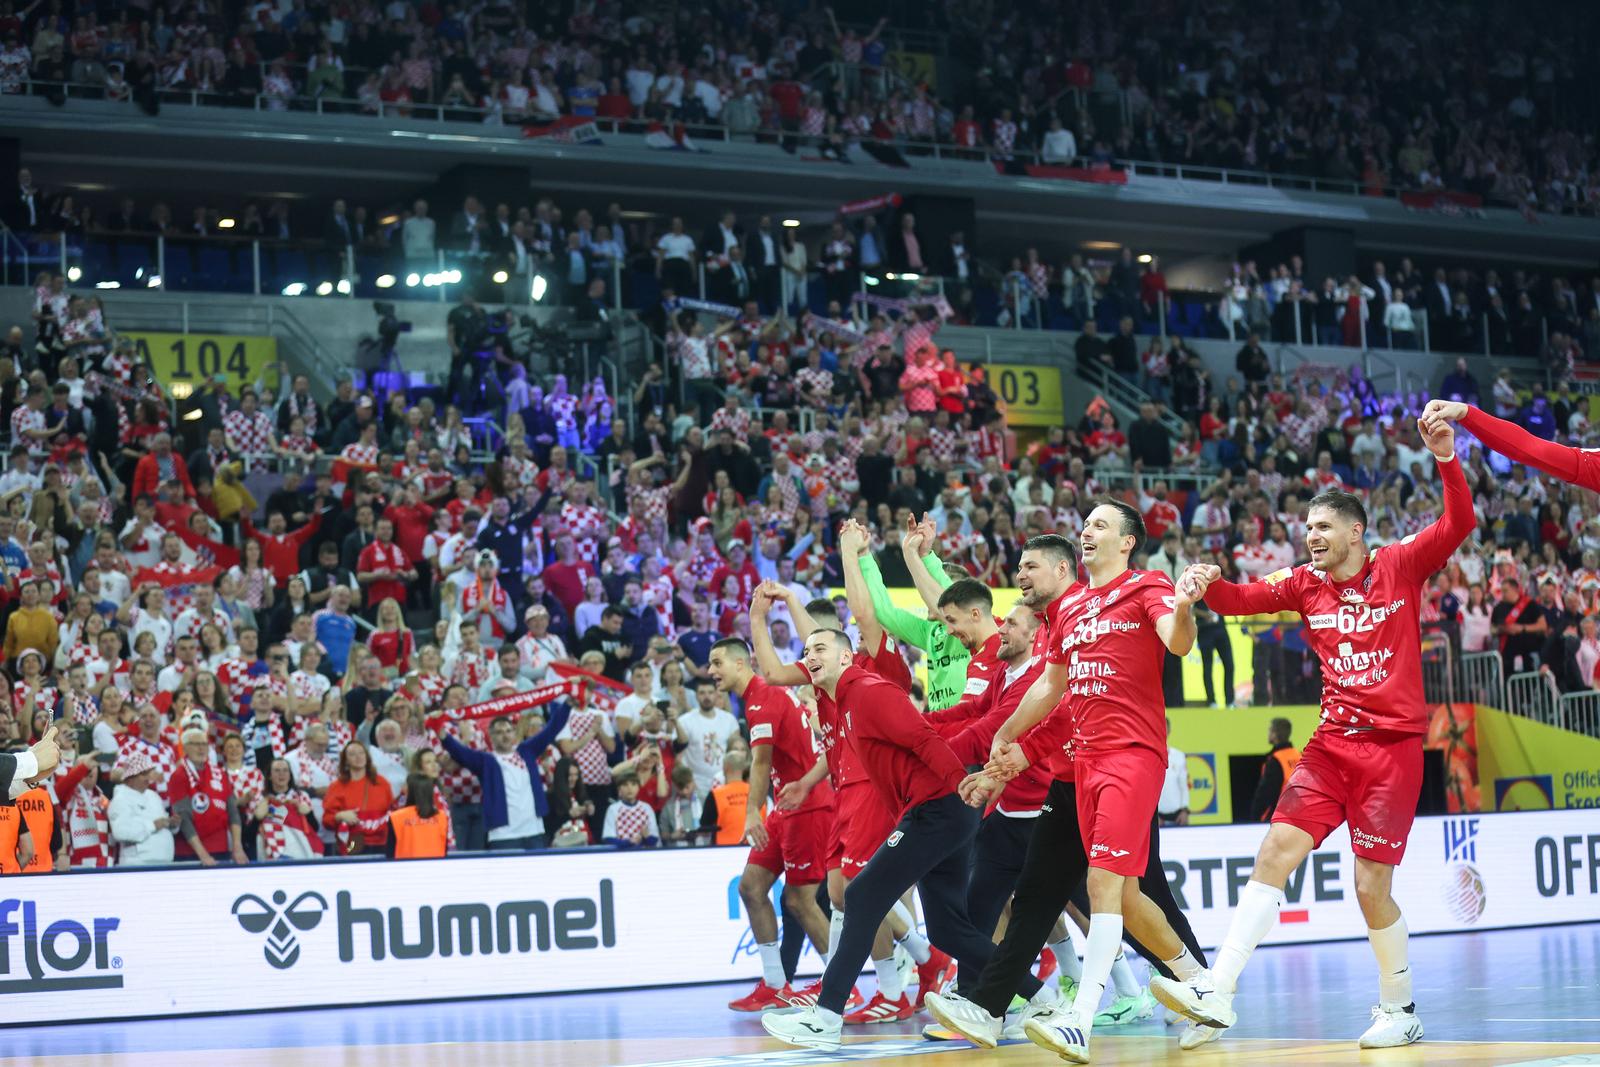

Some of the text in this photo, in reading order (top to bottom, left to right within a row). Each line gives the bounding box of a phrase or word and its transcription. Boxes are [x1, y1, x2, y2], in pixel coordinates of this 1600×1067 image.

[170, 338, 249, 379] 104
[1112, 620, 1141, 632] triglav
[1338, 603, 1374, 634] 62
[1371, 665, 1388, 682] life
[1092, 680, 1107, 696] life
[337, 878, 616, 963] hummel
